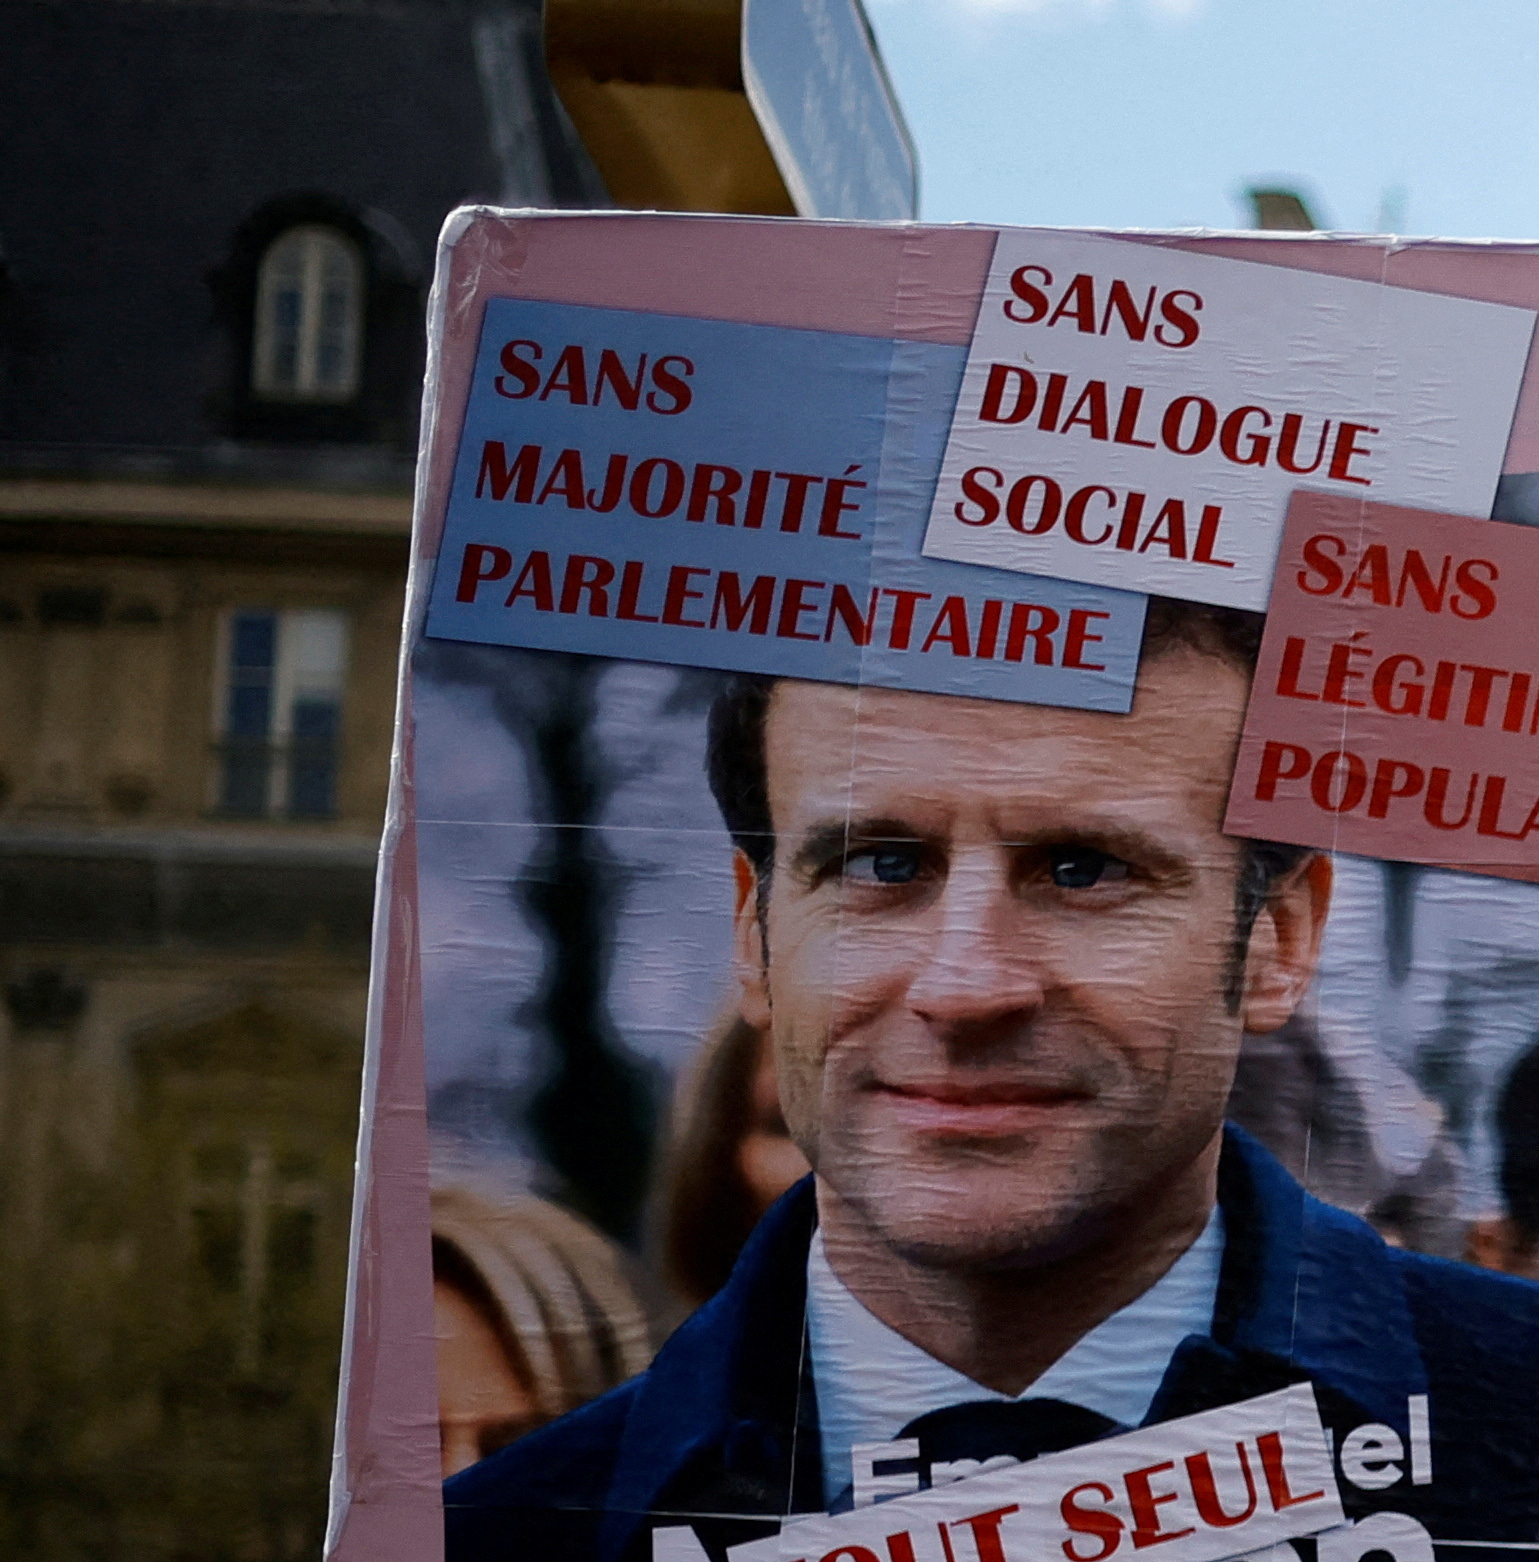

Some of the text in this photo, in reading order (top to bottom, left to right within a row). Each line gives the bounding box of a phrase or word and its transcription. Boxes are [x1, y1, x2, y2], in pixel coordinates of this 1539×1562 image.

[1003, 265, 1203, 349] SANS
[494, 339, 694, 416] SANS
[977, 362, 1379, 485] DIALOGUE
[475, 441, 867, 541] MAJORITÉ
[953, 466, 1236, 568] SOCIAL
[455, 543, 1110, 672] PARLEMENTAIRE
[1297, 534, 1500, 621] SANS
